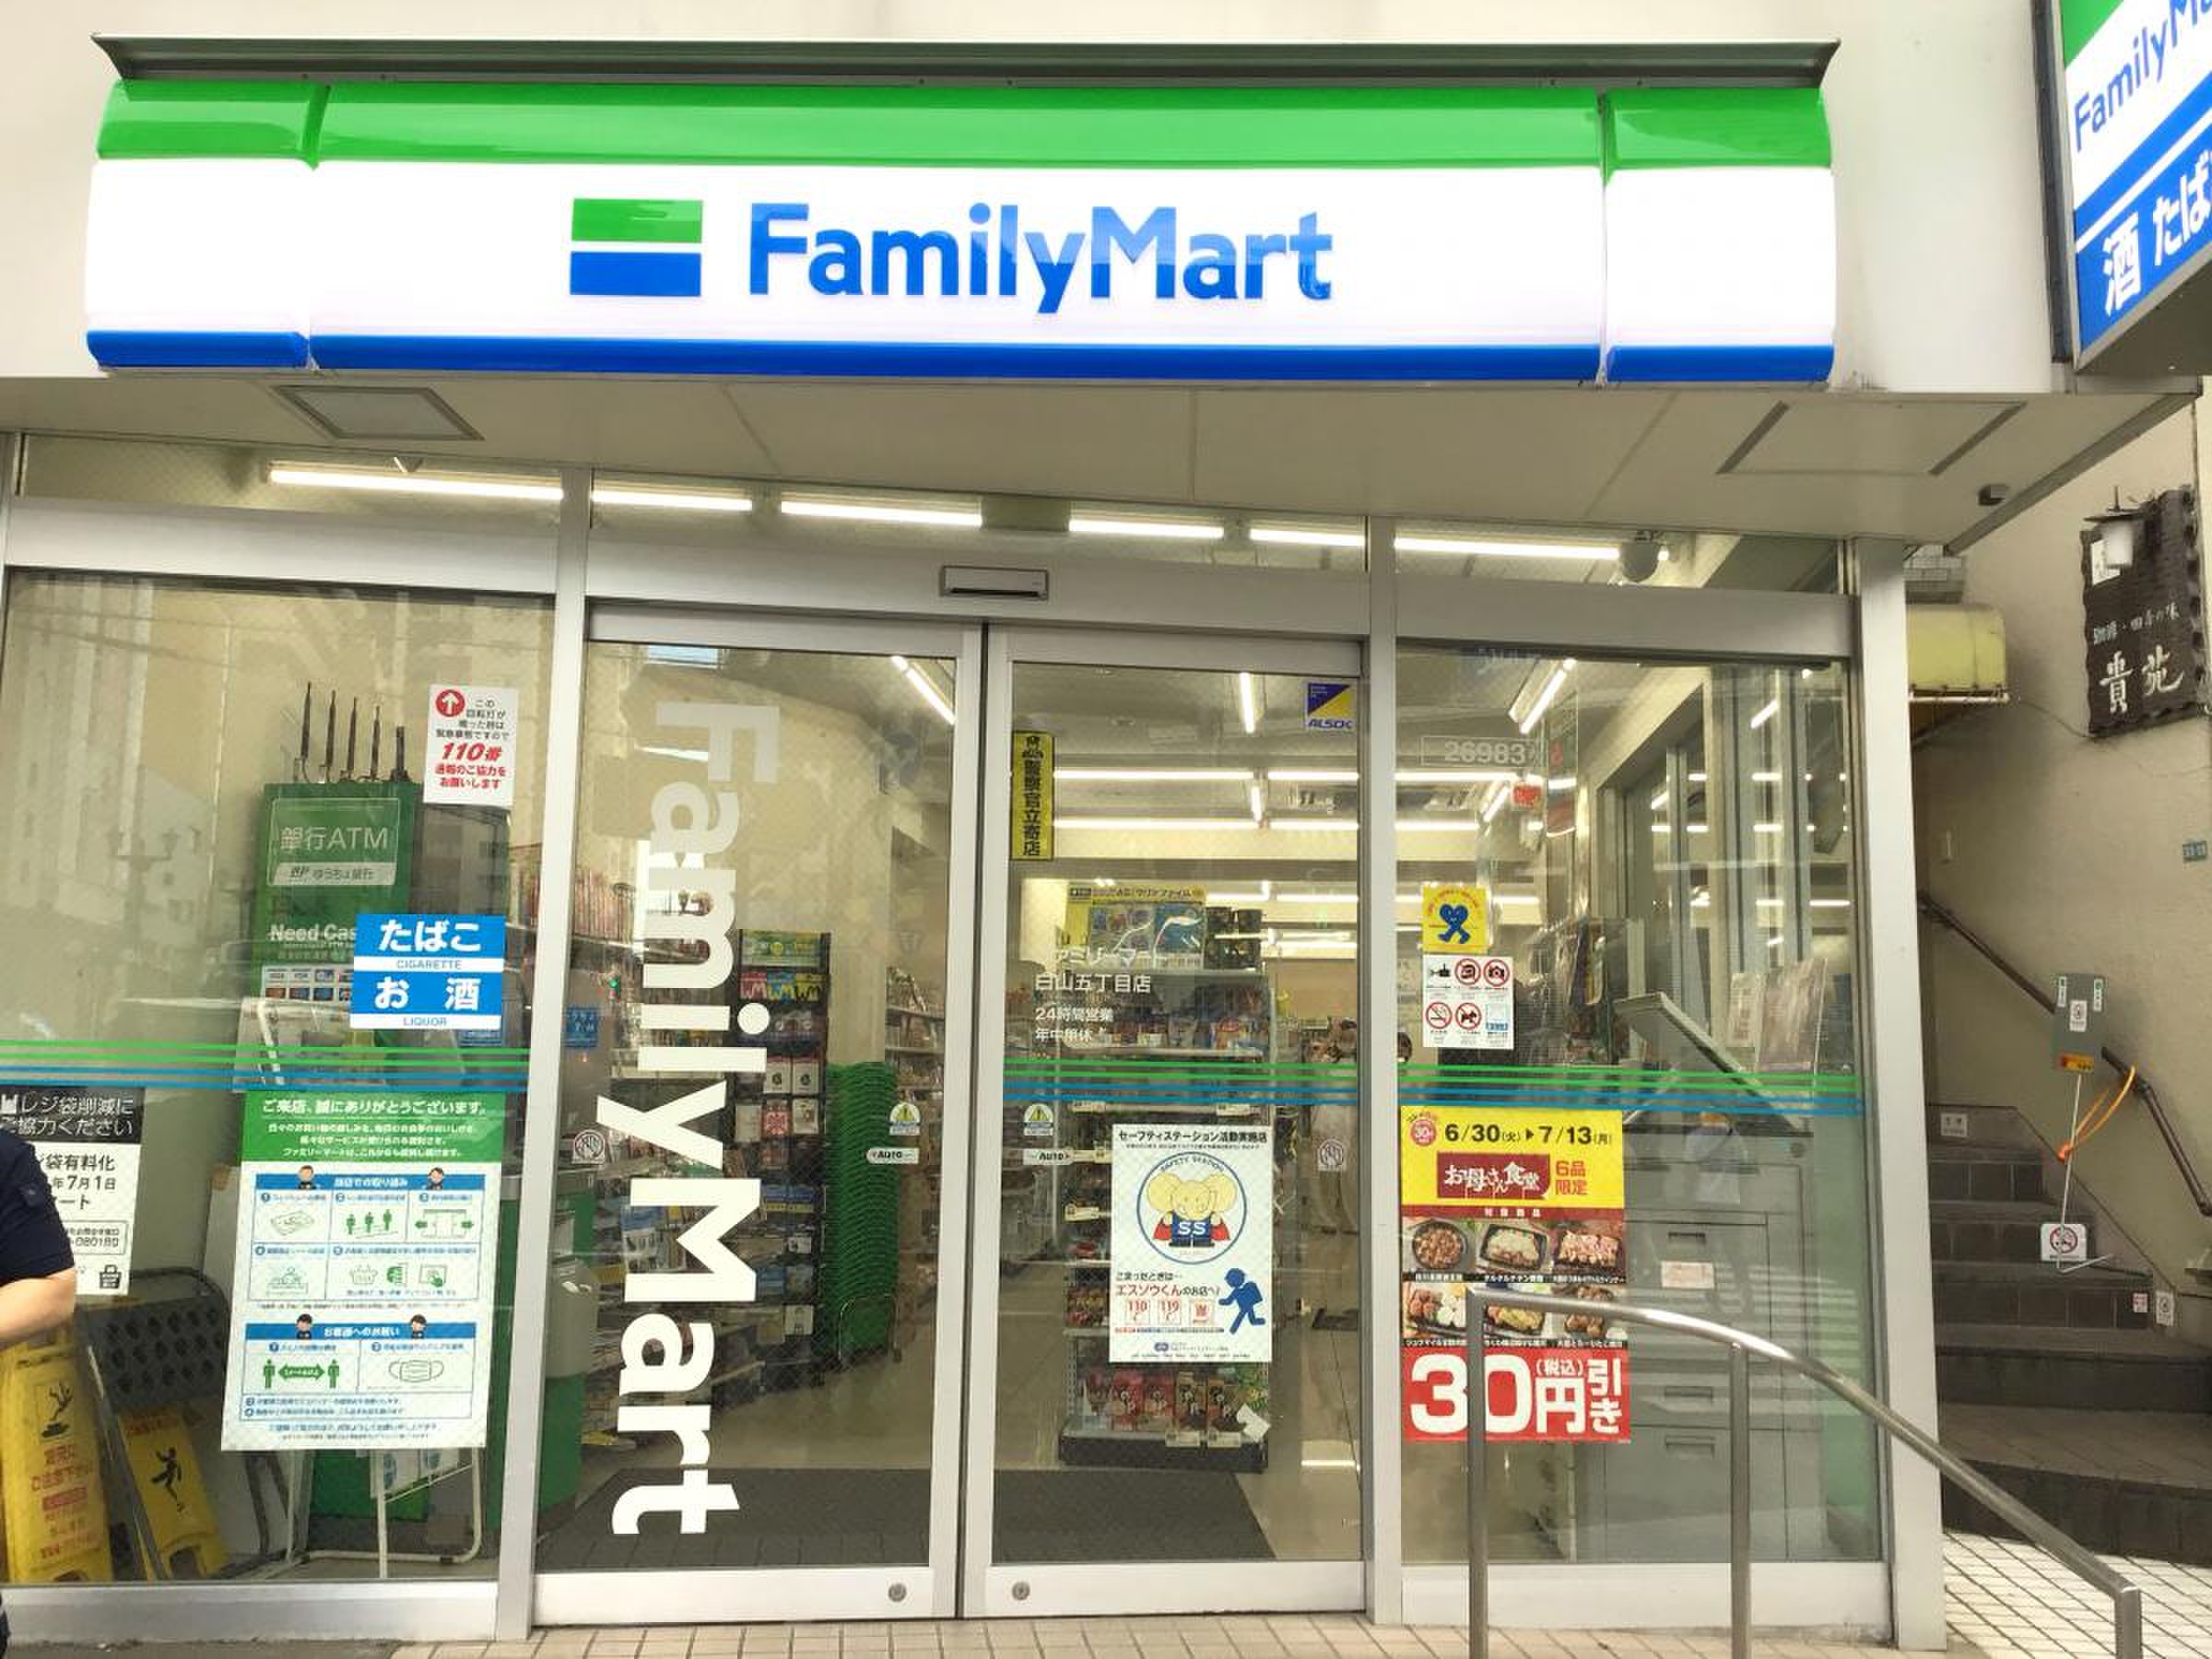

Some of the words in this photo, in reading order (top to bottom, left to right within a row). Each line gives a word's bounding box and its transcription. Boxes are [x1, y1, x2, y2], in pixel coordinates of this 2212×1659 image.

[748, 202, 1334, 313] FamilyMart
[2102, 211, 2142, 316] 酒
[475, 699, 495, 708] この
[441, 742, 503, 762] 110番
[269, 923, 320, 942] Need
[378, 918, 481, 953] たばこ
[395, 959, 462, 970] CIGARETTE
[1034, 972, 1151, 994] 白山五丁目店
[402, 1017, 448, 1027] LIQUOR
[1034, 1006, 1114, 1022] 24時間営業
[21, 1094, 134, 1115] レジ袋削減に
[596, 700, 781, 1535] FamilyMart
[38, 1153, 116, 1172] 袋有料化
[1555, 1159, 1586, 1178] 6品
[1444, 1160, 1540, 1194] お母さん食堂
[1555, 1179, 1588, 1196] 限定
[1177, 1221, 1206, 1236] SS
